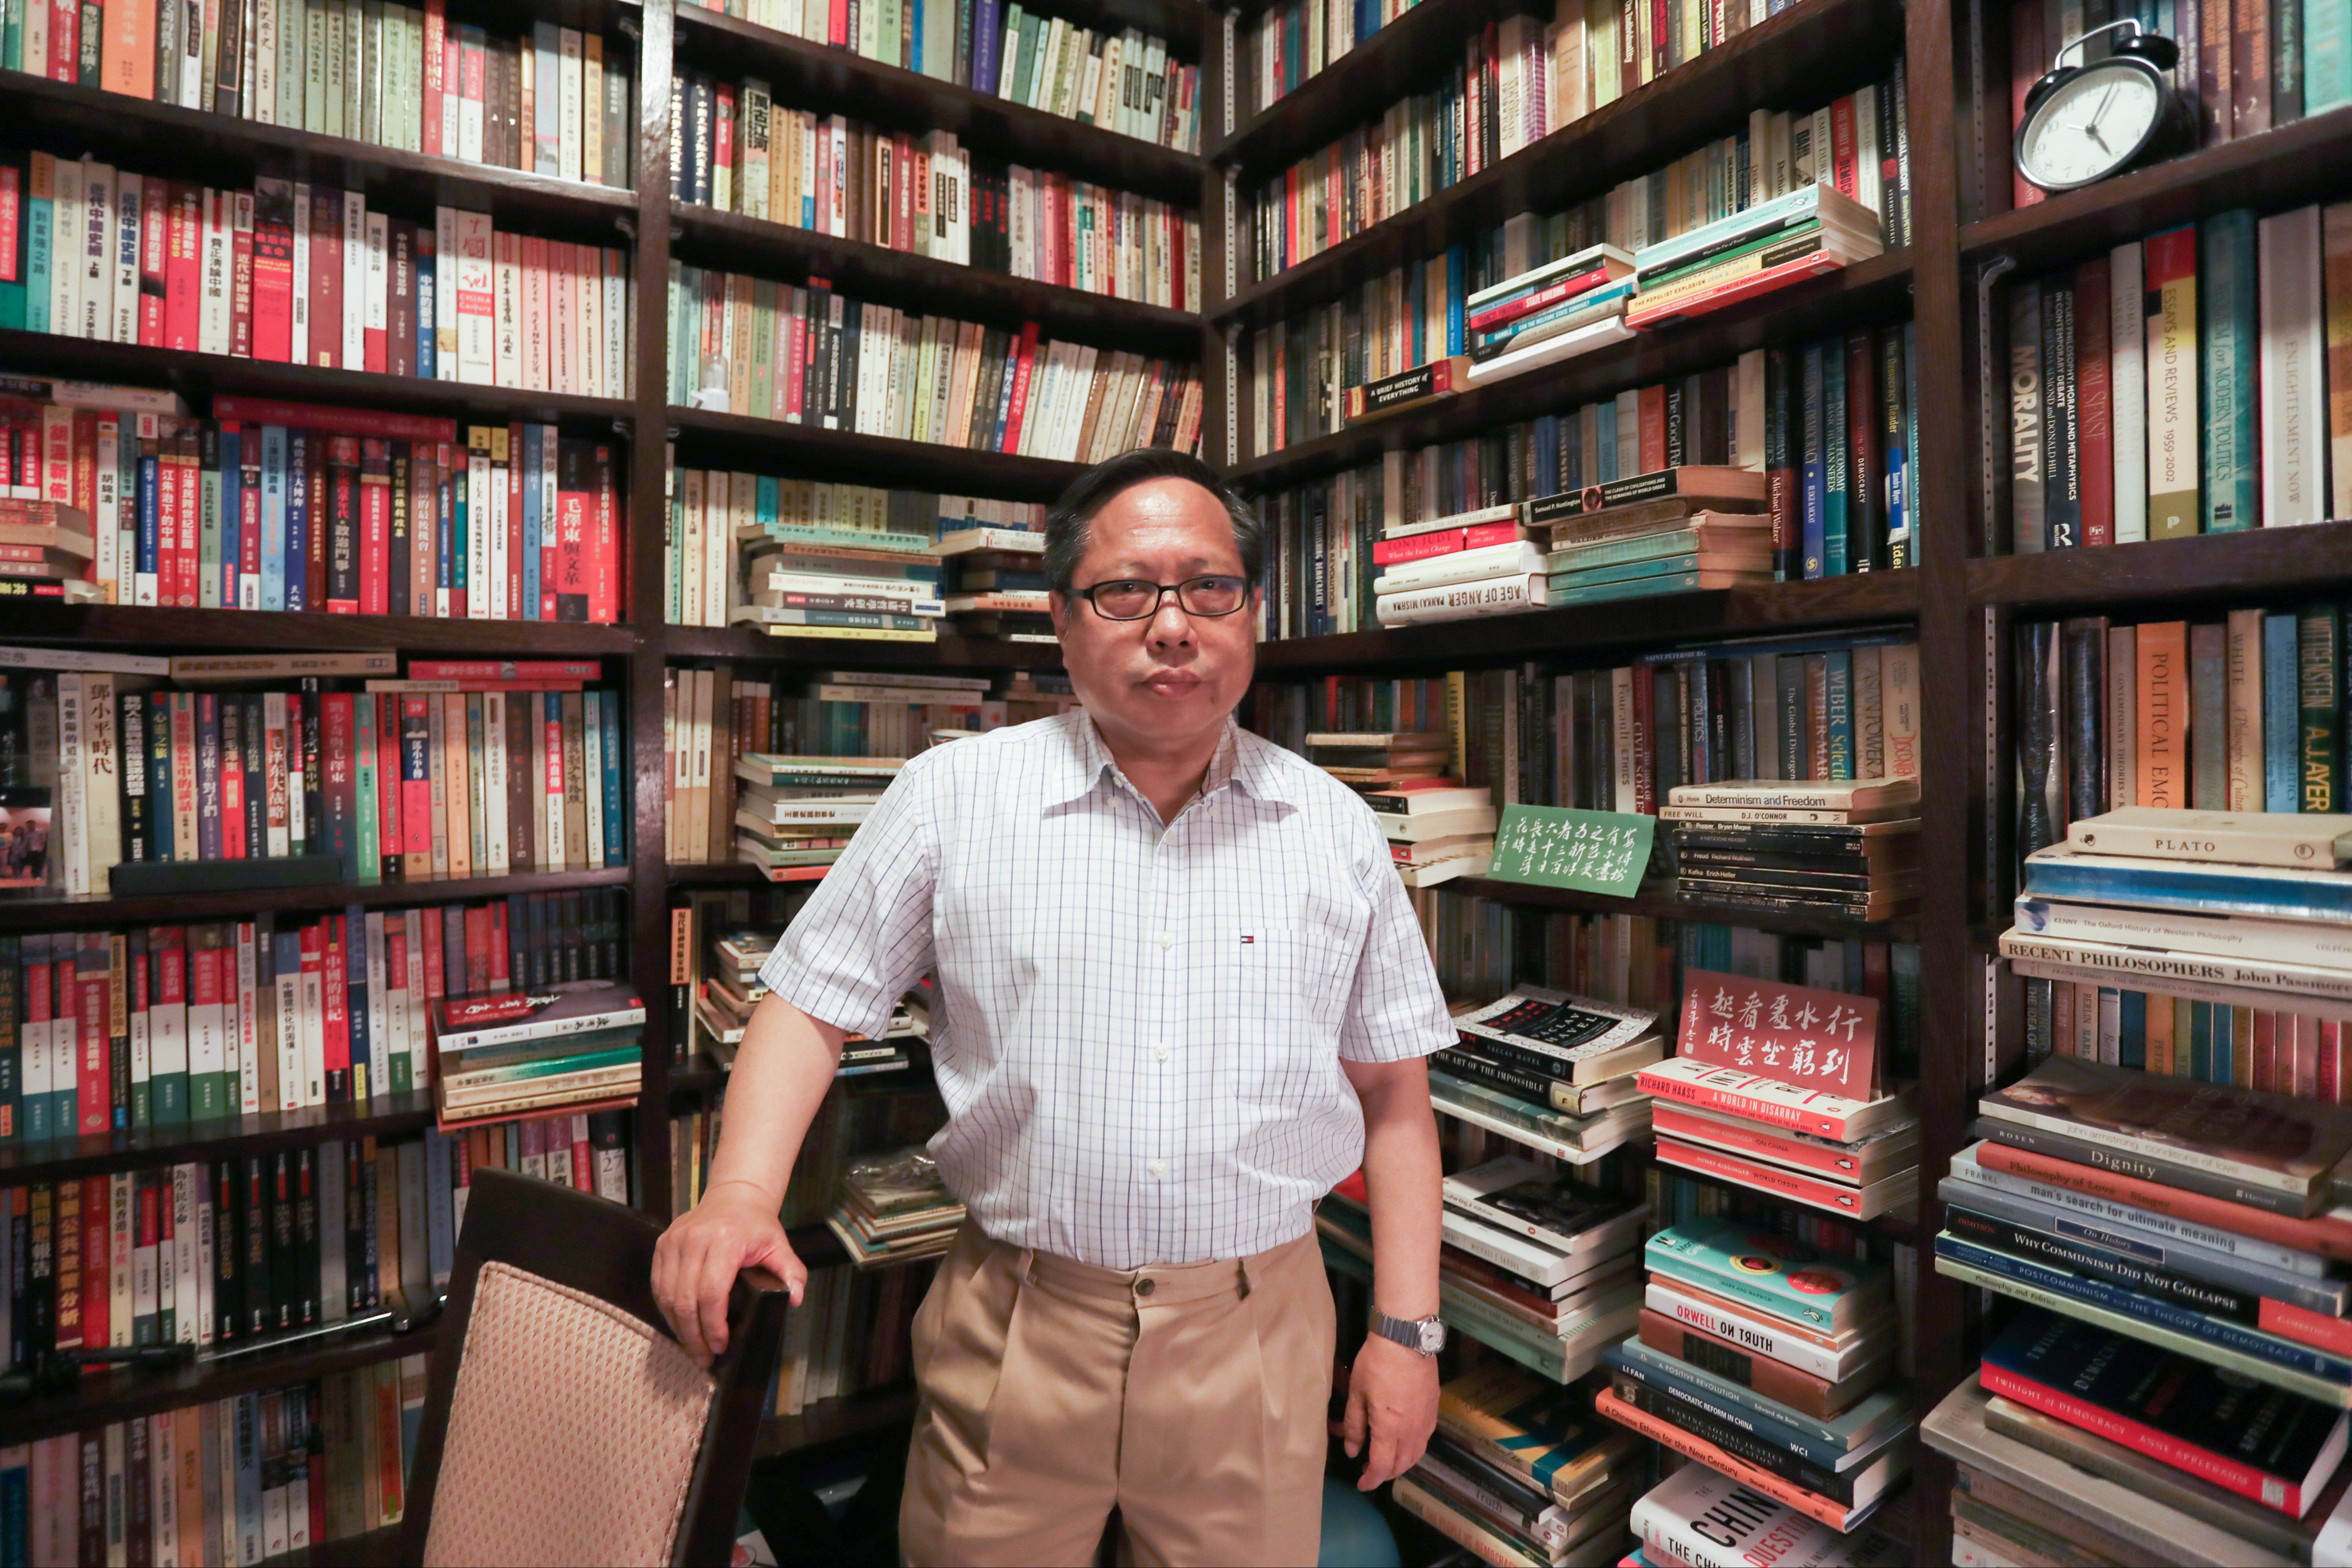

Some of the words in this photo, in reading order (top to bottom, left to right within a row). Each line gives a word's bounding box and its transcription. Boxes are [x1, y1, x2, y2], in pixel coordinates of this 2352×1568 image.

[1624, 16, 1634, 64] Individuality
[1898, 124, 1908, 156] SOCIAL
[1900, 157, 1909, 191] THEORY
[88, 183, 105, 257] 近代中國史綱
[120, 192, 137, 266] 近代中國史綱
[209, 238, 223, 298] 費正清論中國
[1526, 292, 1541, 308] STATE
[1542, 285, 1566, 303] BUILDING
[1646, 289, 1673, 303] POPULIST
[1674, 279, 1705, 295] EXPLOSION
[2056, 292, 2063, 301] IN
[2164, 288, 2177, 333] ESSAYS
[1494, 328, 1513, 340] GAMBLE
[1518, 322, 1527, 331] CAN
[1536, 312, 1555, 326] WELFARE
[1556, 308, 1568, 320] STATE
[1569, 300, 1590, 315] SURVIVE?
[2056, 303, 2064, 373] CONTEMPORARY
[2164, 337, 2177, 365] AND
[1370, 388, 1376, 397] A
[1376, 384, 1394, 396] BRIEF
[1394, 375, 1421, 393] HISTORY
[1422, 373, 1429, 382] of
[1379, 384, 1419, 402] EVERYTHING
[2164, 367, 2177, 423] REVIEWS
[2285, 342, 2300, 466] ENLIGHTENMENT
[2013, 346, 2038, 482] MORALITY
[1836, 449, 1846, 491] ECONOMY
[2165, 428, 2175, 482] 1959-2002
[1772, 476, 1781, 509] Michael
[1827, 463, 1835, 493] NEEDS
[2288, 471, 2300, 504] NOW
[161, 469, 175, 549] 江朱治下的中國
[1535, 505, 1551, 514] Samuel
[1556, 498, 1581, 509] Huntington
[1387, 539, 1420, 551] TONY
[1422, 532, 1452, 544] JUDT
[1773, 512, 1782, 544] Walzer
[1388, 551, 1404, 559] When
[1415, 547, 1429, 555] Facts
[1430, 544, 1451, 553] Change
[1393, 599, 1418, 611] MISHRA
[1420, 596, 1444, 607] PANKAJ
[1448, 590, 1482, 607] ANGER
[1486, 589, 1498, 603] OF
[1501, 585, 1521, 601] AGE
[2232, 634, 2244, 686] WHITE
[2303, 617, 2332, 708] WITTGENSTEIN
[1829, 671, 1845, 725] WEBER
[91, 683, 113, 775] 鄧小平時代
[1695, 698, 1704, 742] POLITICS
[1622, 742, 1630, 785] ETHICS
[1664, 810, 1681, 818] FREE
[1685, 811, 1704, 819] WILL
[1755, 812, 1788, 820] O'CONNOR
[1705, 793, 1761, 806] Determinism
[1765, 795, 1780, 805] and
[1783, 795, 1825, 807] Freedom
[2155, 839, 2216, 853] PLATO
[2054, 917, 2077, 926] KENNY
[2099, 921, 2123, 930] Oxford
[2125, 923, 2150, 934] History
[2164, 927, 2195, 938] Western
[2197, 931, 2243, 943] Philosophy
[2008, 943, 2074, 962] RECENT
[2081, 951, 2225, 979] PHILOSOPHERS
[2234, 970, 2269, 984] John
[1708, 986, 1734, 1052] 起時
[1735, 992, 1763, 1066] 看雲
[1821, 1005, 1862, 1085] 行到
[1436, 1050, 1449, 1060] THE
[1451, 1055, 1466, 1068] ART
[1468, 1060, 1477, 1071] OF
[1480, 1065, 1495, 1077] THE
[1497, 1067, 1544, 1093] IMPOSSIBLE
[1640, 1076, 1670, 1095] RICHARD
[1673, 1084, 1696, 1099] HAASS
[1713, 1091, 1717, 1101] A
[1720, 1093, 1746, 1108] WORLD
[1749, 1099, 1757, 1111] IN
[1761, 1102, 1801, 1122] DISARRAY
[1697, 1156, 1716, 1166] HENRY
[1718, 1162, 1750, 1176] KISSINGER
[1753, 1172, 1776, 1183] WORLD
[1777, 1179, 1798, 1190] ORDER
[1966, 1168, 1998, 1184] FRANKL
[2030, 1185, 2061, 1201] man's
[2066, 1194, 2103, 1213] search
[2107, 1205, 2123, 1218] for
[2128, 1213, 2176, 1232] ultimate
[2181, 1226, 2235, 1252] meaning
[1677, 1304, 1716, 1330] ORWELL
[1622, 1365, 1630, 1374] LI
[1631, 1368, 1645, 1380] FAN
[1669, 1386, 1703, 1410] DEMOCRATIC
[1704, 1402, 1727, 1419] REFORM
[1727, 1412, 1734, 1422] IN
[1734, 1416, 1753, 1432] CHINA
[1790, 1442, 1808, 1457] WCI
[1665, 1364, 1695, 1383] POSITIVE
[1696, 1376, 1740, 1401] REVOLUTION
[1754, 1403, 1775, 1416] Edward
[1785, 1415, 1799, 1427] Bono
[1668, 1536, 1690, 1563] THE
